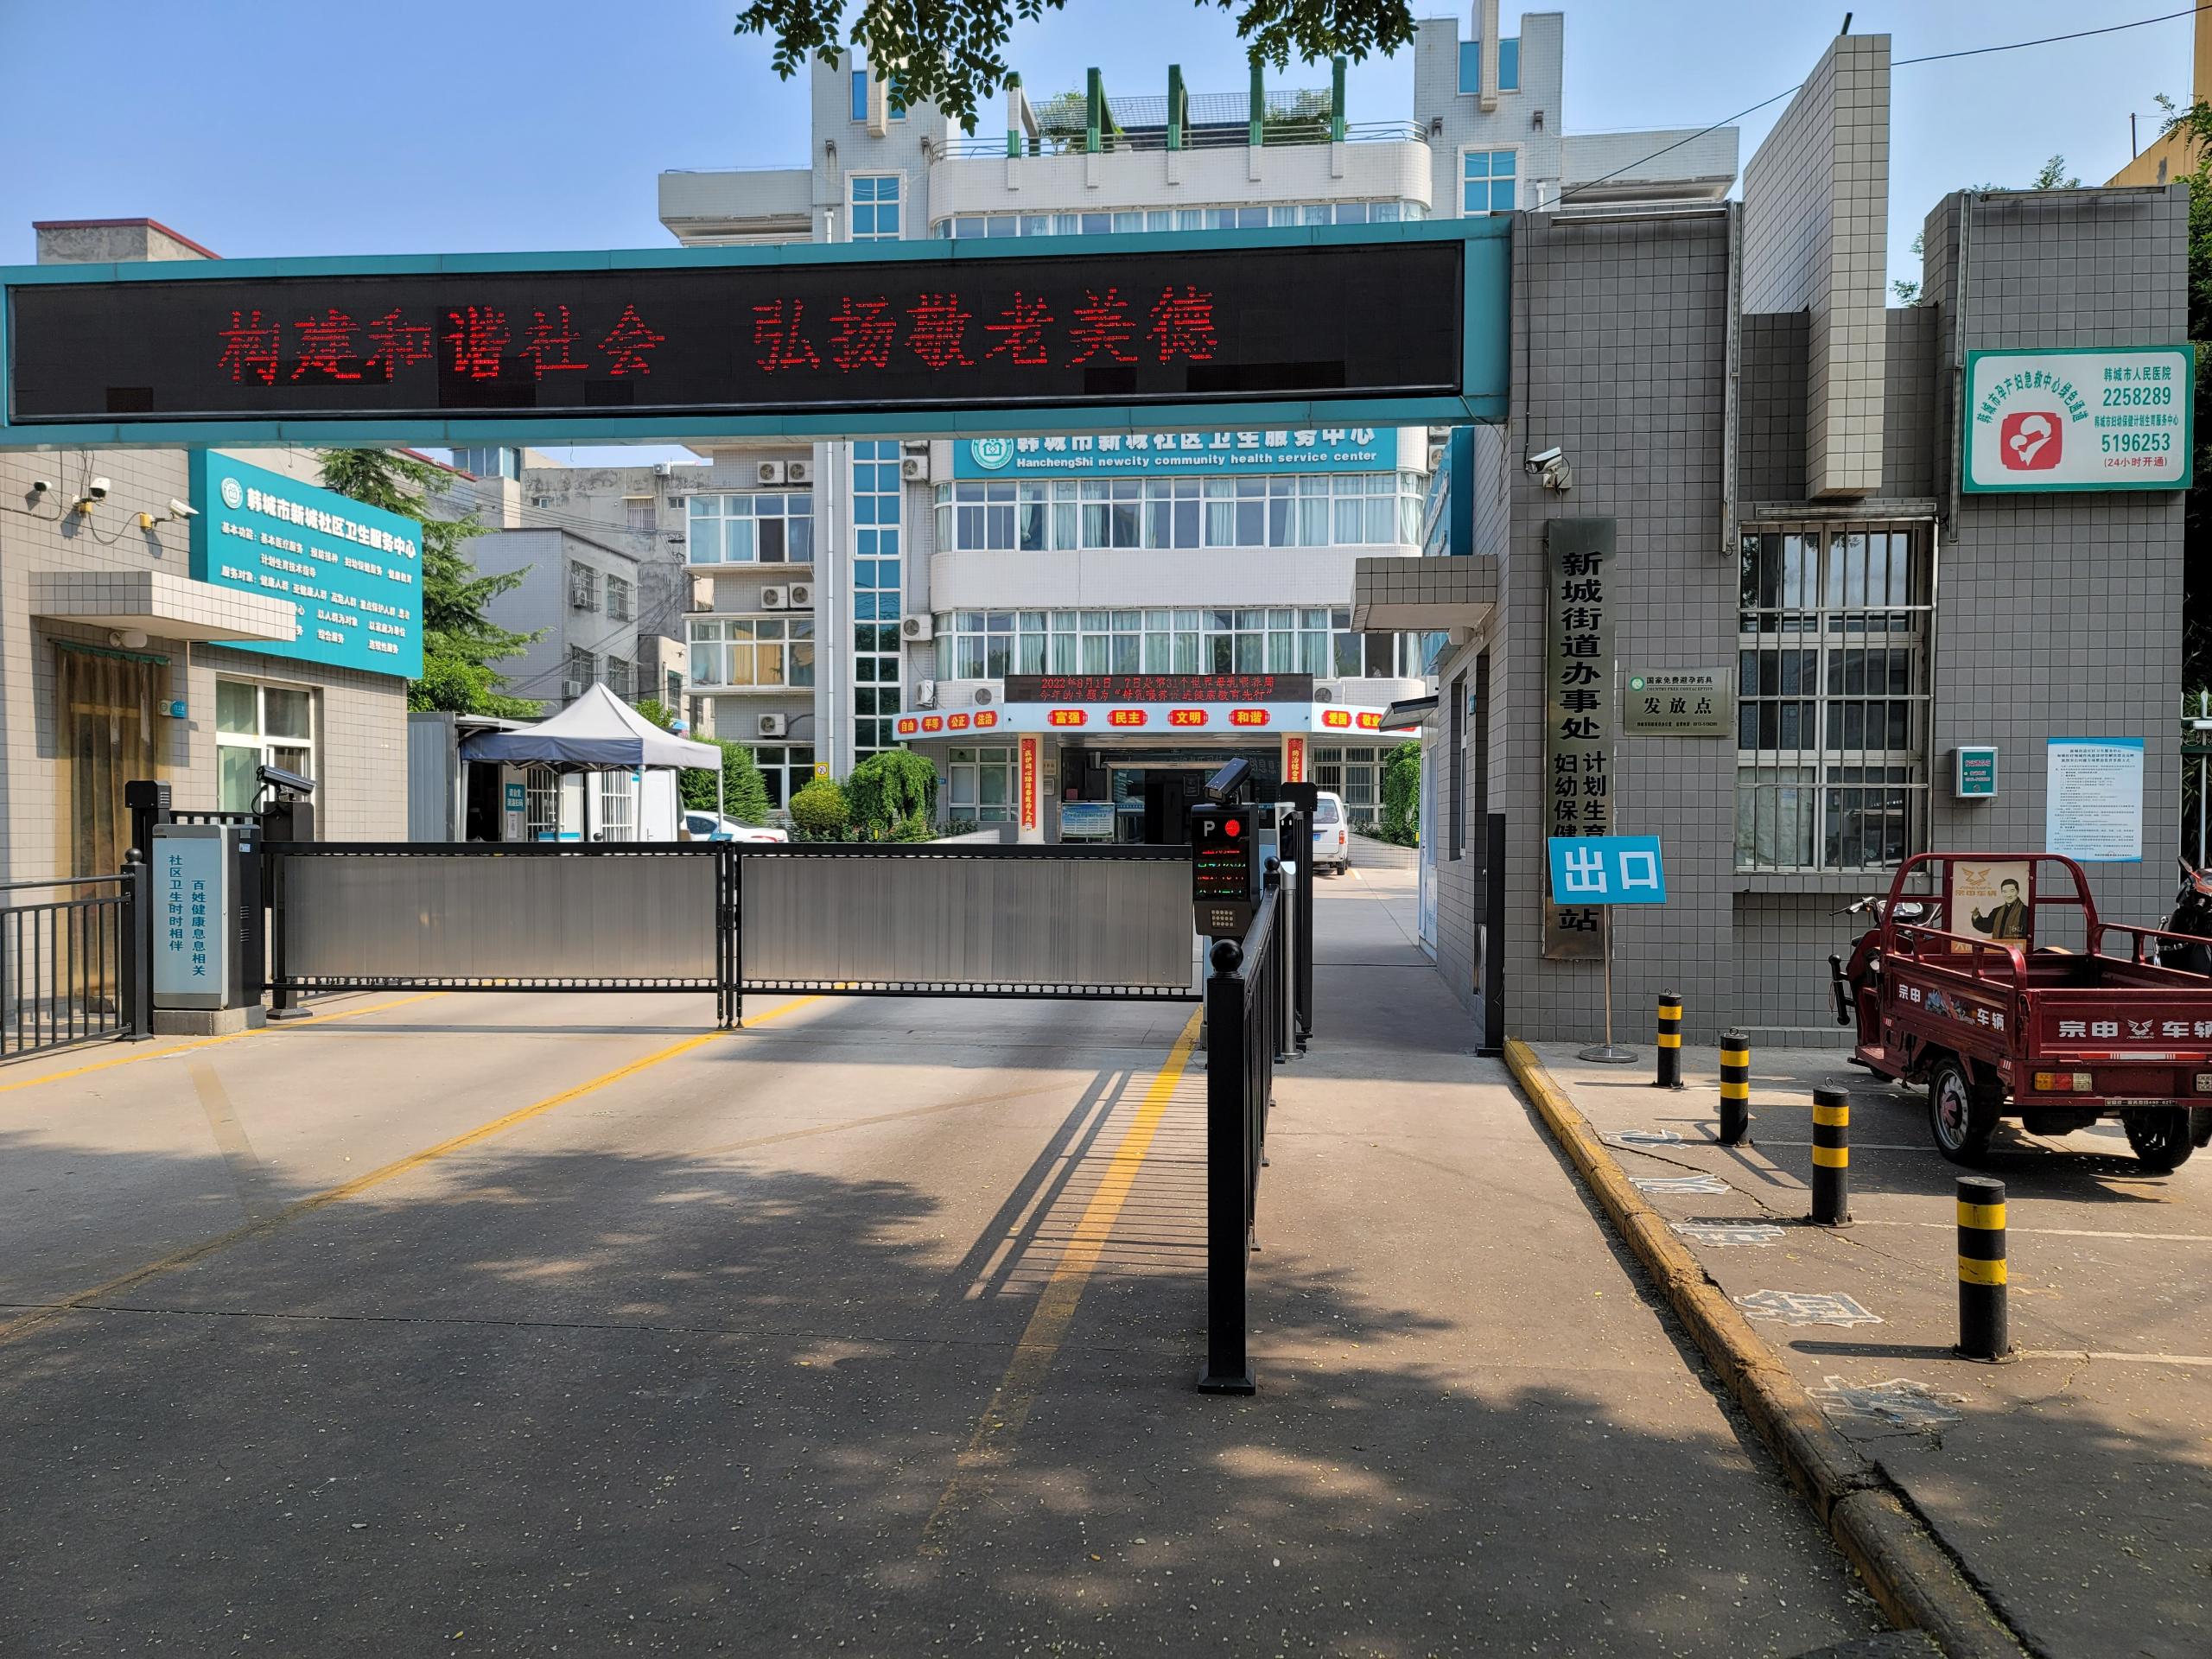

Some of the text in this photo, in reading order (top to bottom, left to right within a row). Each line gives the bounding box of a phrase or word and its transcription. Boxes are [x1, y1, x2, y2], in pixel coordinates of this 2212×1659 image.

[217, 284, 1218, 386] 构建和谐社会 弘扬敬老美德
[2103, 365, 2171, 381] 韩城市人民医院
[1976, 370, 2089, 424] 韩城市孕产妇急救中心绿色通道
[2102, 387, 2171, 406] 2258289
[2094, 414, 2178, 428] 韩城市妇幼保健计划生育服务中心
[2101, 434, 2171, 453] 5196253
[1017, 449, 1377, 469] HanchengShi newcity community health service center
[2104, 456, 2167, 467] (24小时开通)
[247, 488, 416, 559] 韩城市新城社区卫生服务中心
[310, 547, 339, 564] 预防接种
[260, 553, 316, 578] 计划生育技术指导
[331, 592, 357, 607] 高危人群
[317, 628, 345, 644] 综合服务
[1559, 550, 1604, 741] 新城街道办事处
[1644, 697, 1712, 715] 发放点
[901, 712, 993, 732] 自由 平等 公正 法治
[1055, 710, 1262, 724] 富强 民主 文明 和谐
[1328, 711, 1348, 725] 爱国
[1205, 821, 1215, 836] P
[1565, 846, 1658, 893] 出口
[168, 855, 183, 951] 社区卫生时时相伴
[192, 880, 206, 976] 百姓健康息息相关
[1559, 908, 1598, 932] 站
[1898, 983, 1921, 1003] 宗申
[1977, 1007, 2005, 1032] 车辆
[2059, 1020, 2212, 1039] 宗申 车辆
